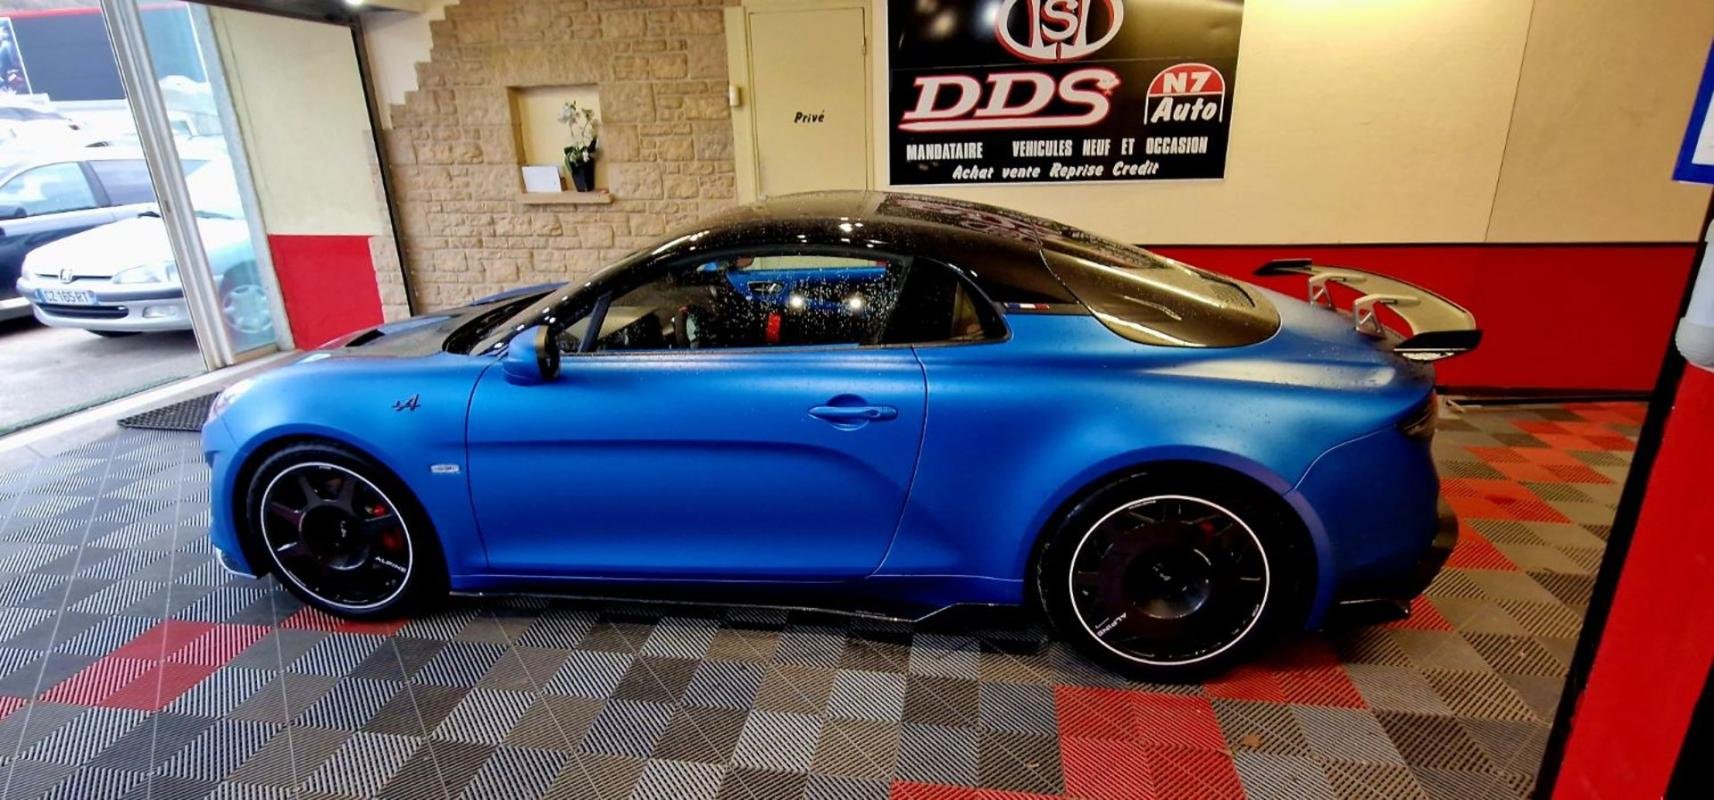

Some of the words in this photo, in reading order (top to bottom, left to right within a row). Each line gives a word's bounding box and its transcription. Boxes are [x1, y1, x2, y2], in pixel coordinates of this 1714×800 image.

[1162, 71, 1212, 93] N7
[898, 69, 1121, 131] DDS
[1151, 97, 1218, 123] Auto
[794, 109, 825, 124] Privé
[906, 142, 983, 161] MANDATAIRE
[1012, 140, 1073, 157] VEHICULES
[1082, 138, 1111, 156] NEUF
[1121, 138, 1135, 155] ET
[1145, 136, 1208, 154] OCCASION
[952, 165, 994, 179] Achat
[1002, 165, 1041, 178] vente
[1050, 162, 1104, 180] Reprise
[1112, 160, 1160, 176] Credit
[1096, 611, 1127, 637] ALPINE
